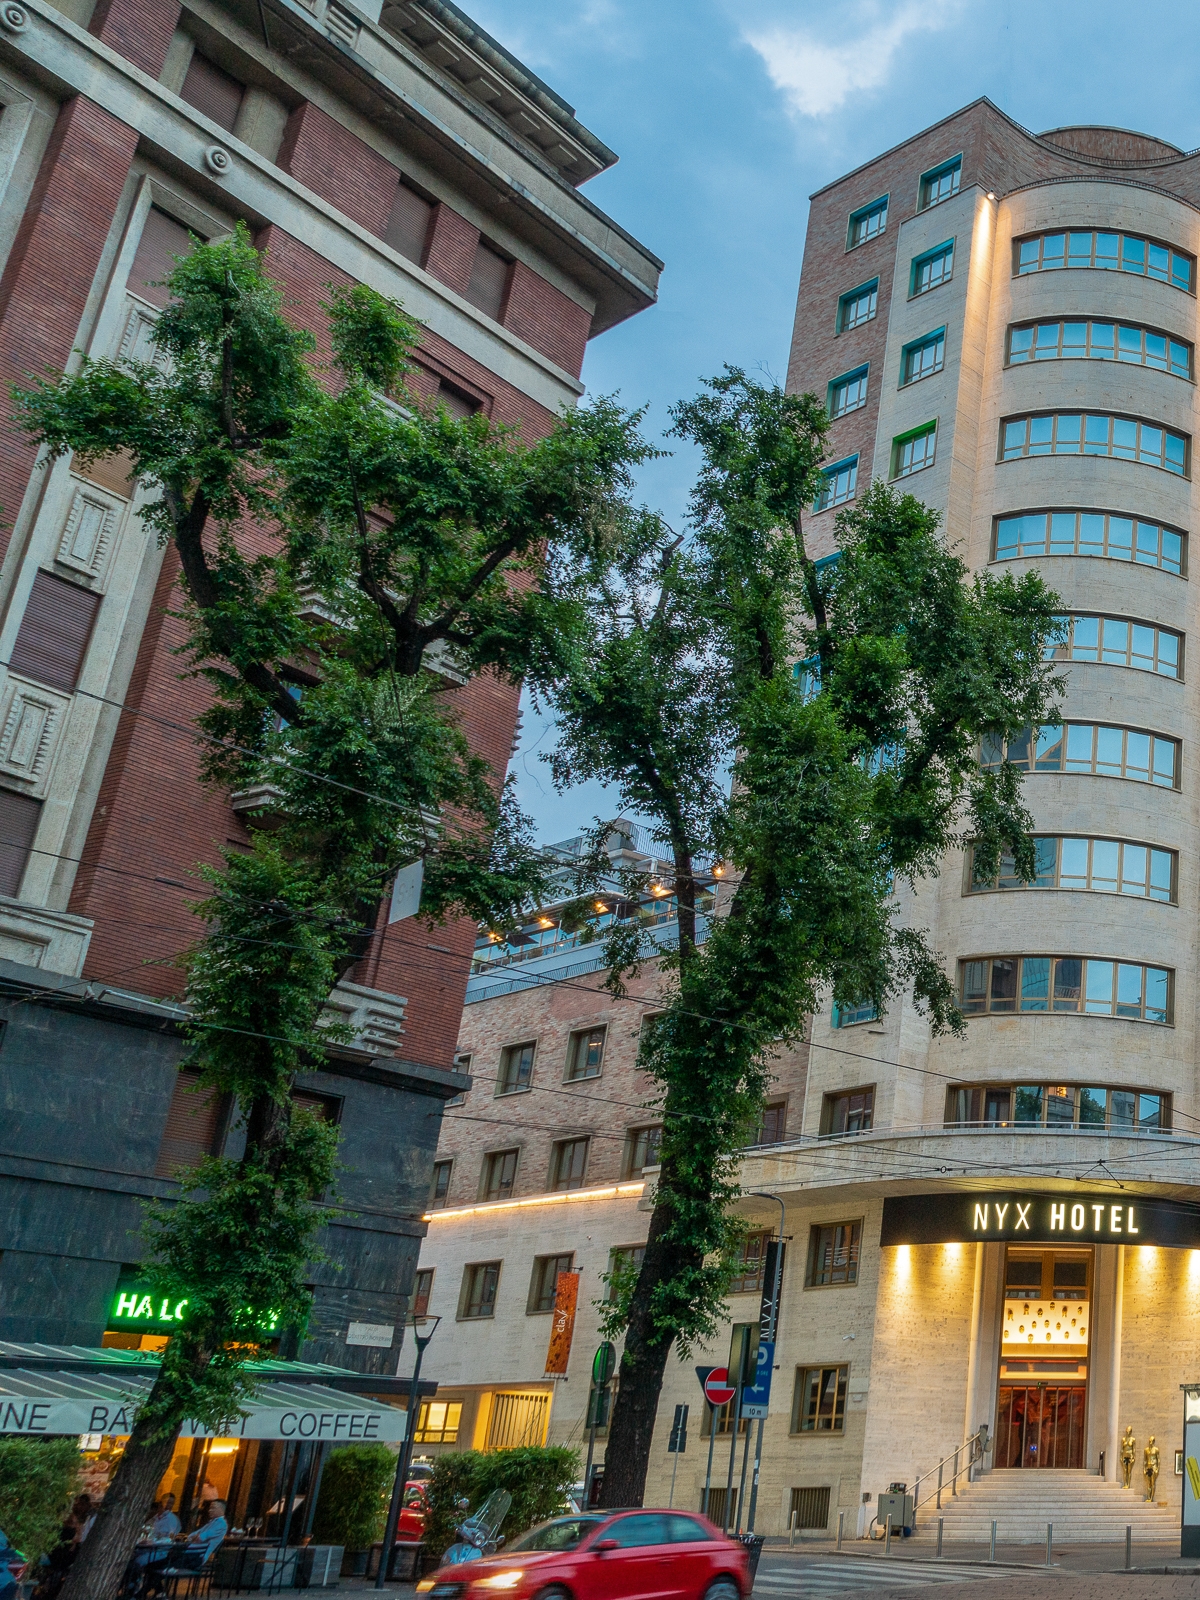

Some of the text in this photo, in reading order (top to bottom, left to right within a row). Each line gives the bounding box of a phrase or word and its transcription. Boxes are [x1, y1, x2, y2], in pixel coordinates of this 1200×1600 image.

[974, 1203, 1138, 1233] NYX HOTEL
[88, 1406, 135, 1432] BA
[280, 1412, 381, 1438] COFFEE
[748, 1408, 756, 1416] 10
